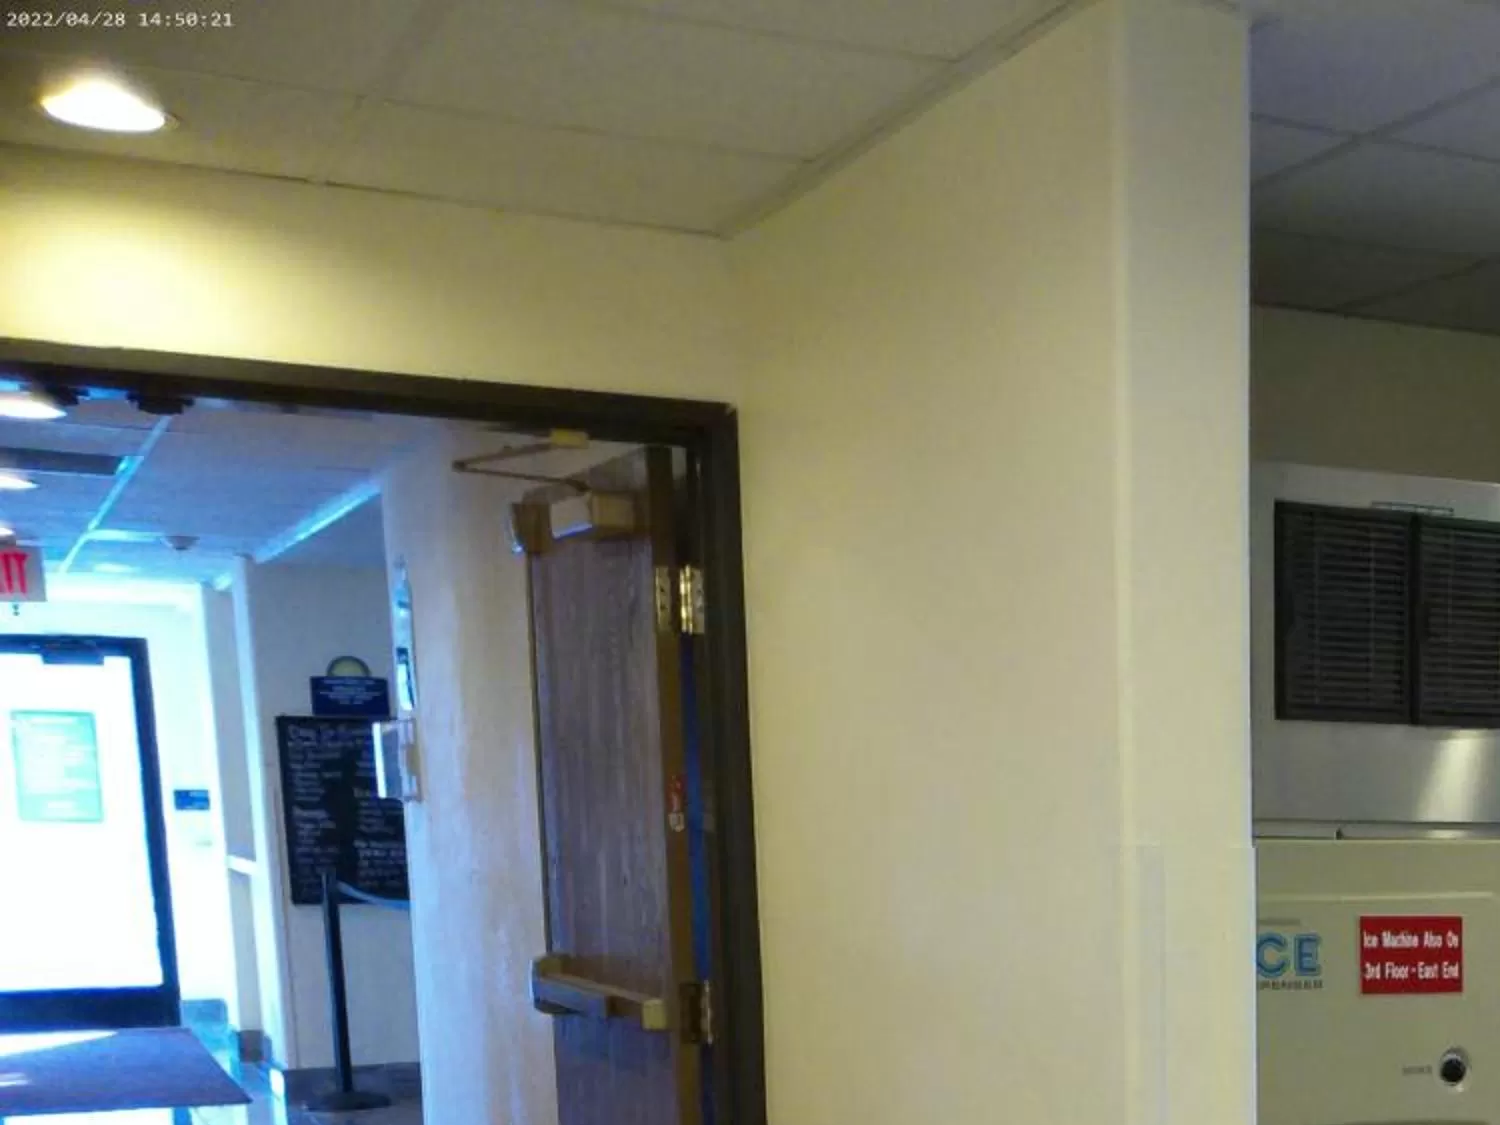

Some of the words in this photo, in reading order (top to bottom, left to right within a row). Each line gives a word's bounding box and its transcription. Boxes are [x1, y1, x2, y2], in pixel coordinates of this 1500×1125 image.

[0, 552, 29, 594] IT
[1363, 930, 1378, 948] Ice
[1382, 930, 1419, 949] Machine
[1423, 930, 1443, 948] Also
[1364, 962, 1380, 980] 3rd
[1386, 961, 1409, 980] Floor
[1418, 961, 1439, 980] East
[1442, 961, 1459, 979] End
